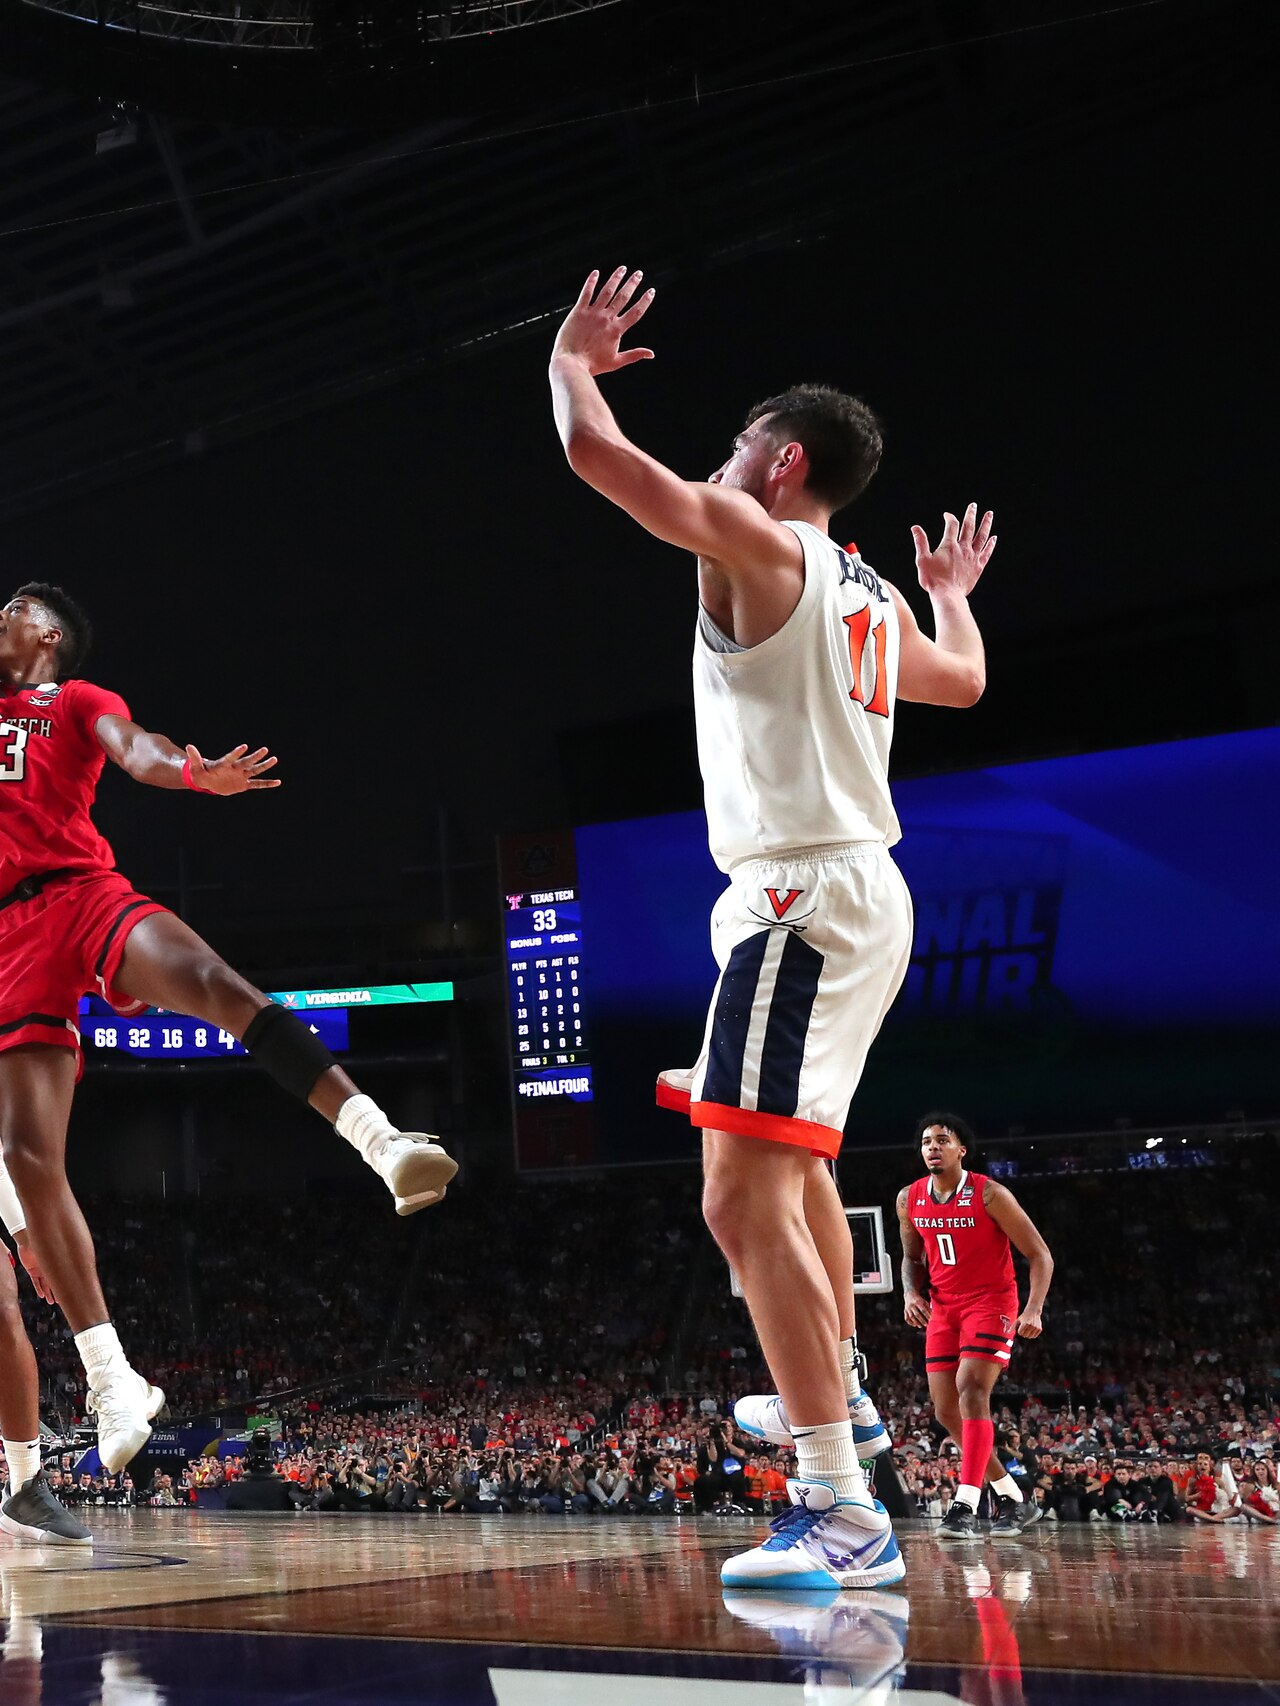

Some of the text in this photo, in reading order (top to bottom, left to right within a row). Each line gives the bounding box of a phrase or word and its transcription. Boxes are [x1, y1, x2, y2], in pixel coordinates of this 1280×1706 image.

[842, 602, 890, 719] 11
[531, 890, 574, 904] TEXAS TECH
[533, 909, 557, 932] 33
[511, 938, 542, 949] BONUS
[536, 960, 548, 969] PTS
[552, 958, 563, 967] AST
[568, 956, 579, 965] FLS
[517, 970, 578, 986] 0 5 1 0
[305, 991, 372, 1005] VIRGINIA
[519, 986, 578, 1002] 1 10 0 0
[518, 1003, 579, 1018] 13 2 2 0
[519, 1020, 581, 1035] 23 5 2 0
[95, 1028, 118, 1048] 68
[129, 1028, 151, 1048] 32
[162, 1029, 183, 1048] 16
[195, 1028, 207, 1048] 8
[519, 1036, 582, 1051] 25 8 0 2
[522, 1058, 540, 1067] FOULS
[542, 1057, 547, 1065] 3
[570, 1054, 575, 1062] 3
[519, 1078, 589, 1096] #FINALFOUR
[914, 1217, 975, 1228] TEXAS TECH
[936, 1234, 956, 1266] 0
